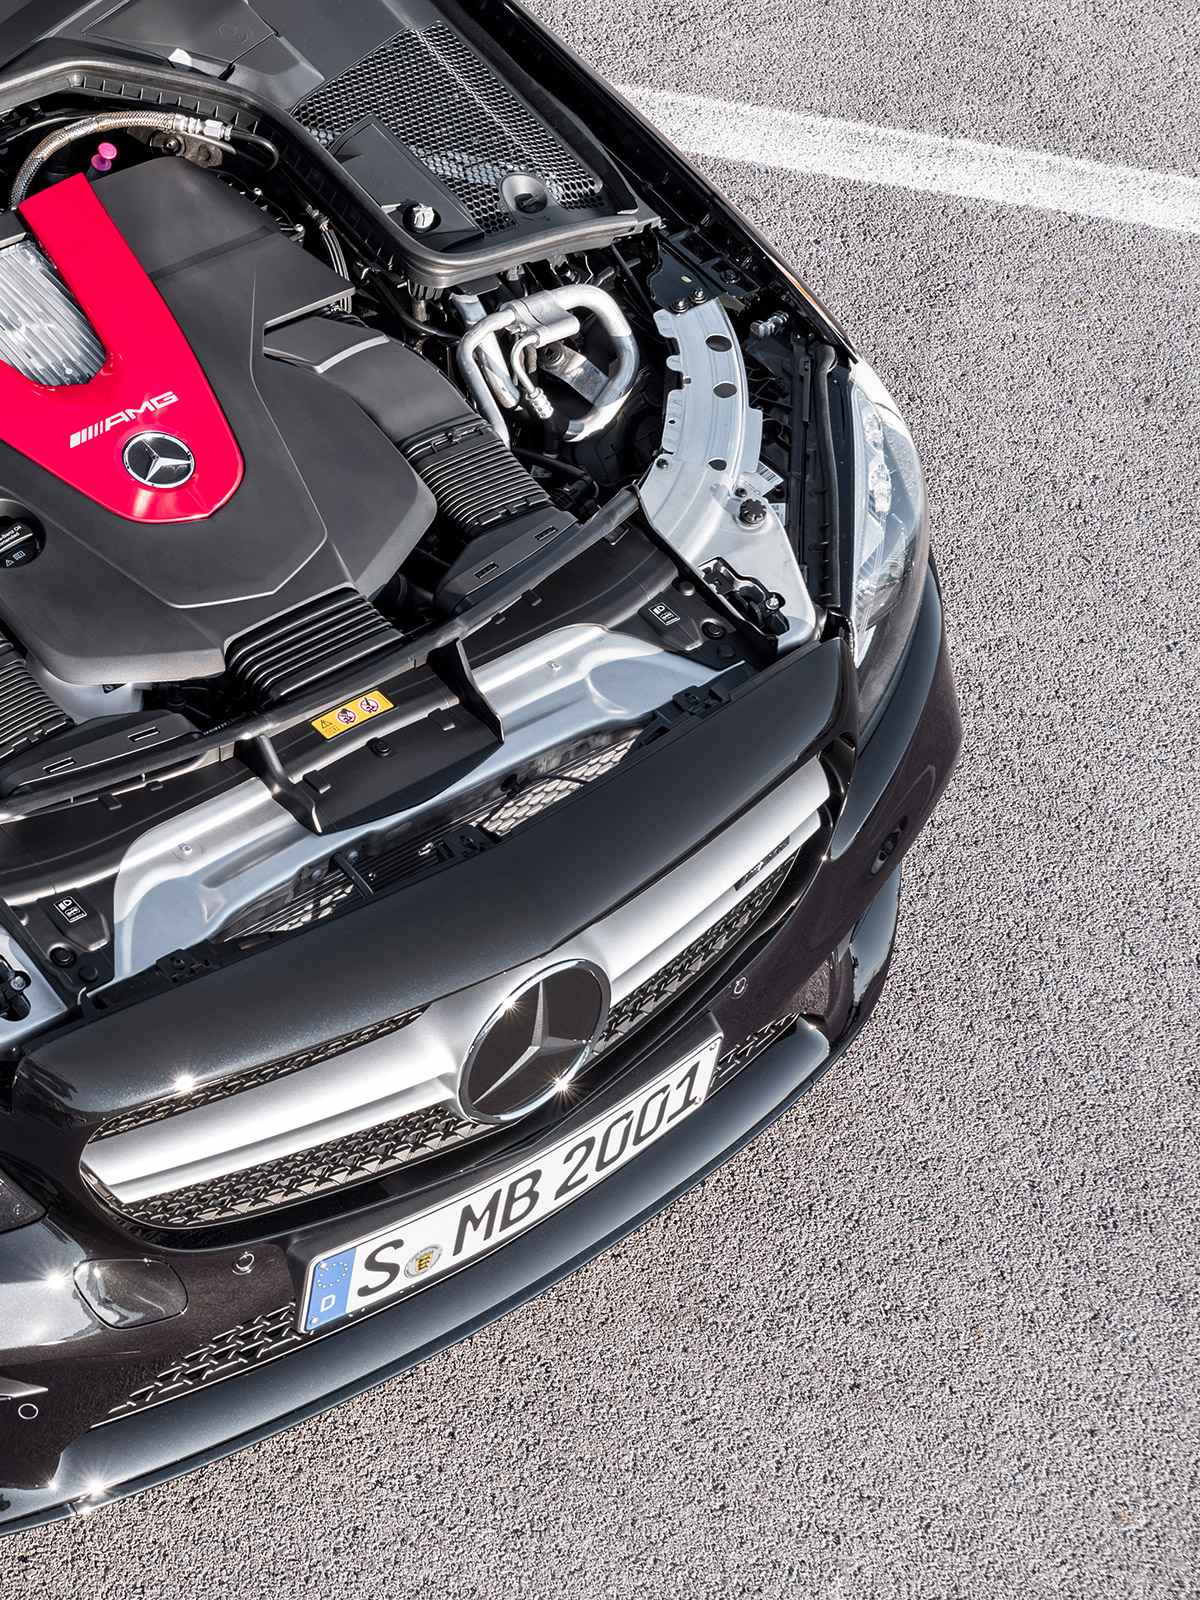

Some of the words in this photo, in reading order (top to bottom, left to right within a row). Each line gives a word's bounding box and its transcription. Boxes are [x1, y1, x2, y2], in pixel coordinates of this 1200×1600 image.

[105, 390, 179, 432] AMG
[357, 1238, 405, 1298] S
[452, 1168, 542, 1257] MB
[554, 1059, 701, 1201] 2001
[319, 1293, 337, 1313] D
